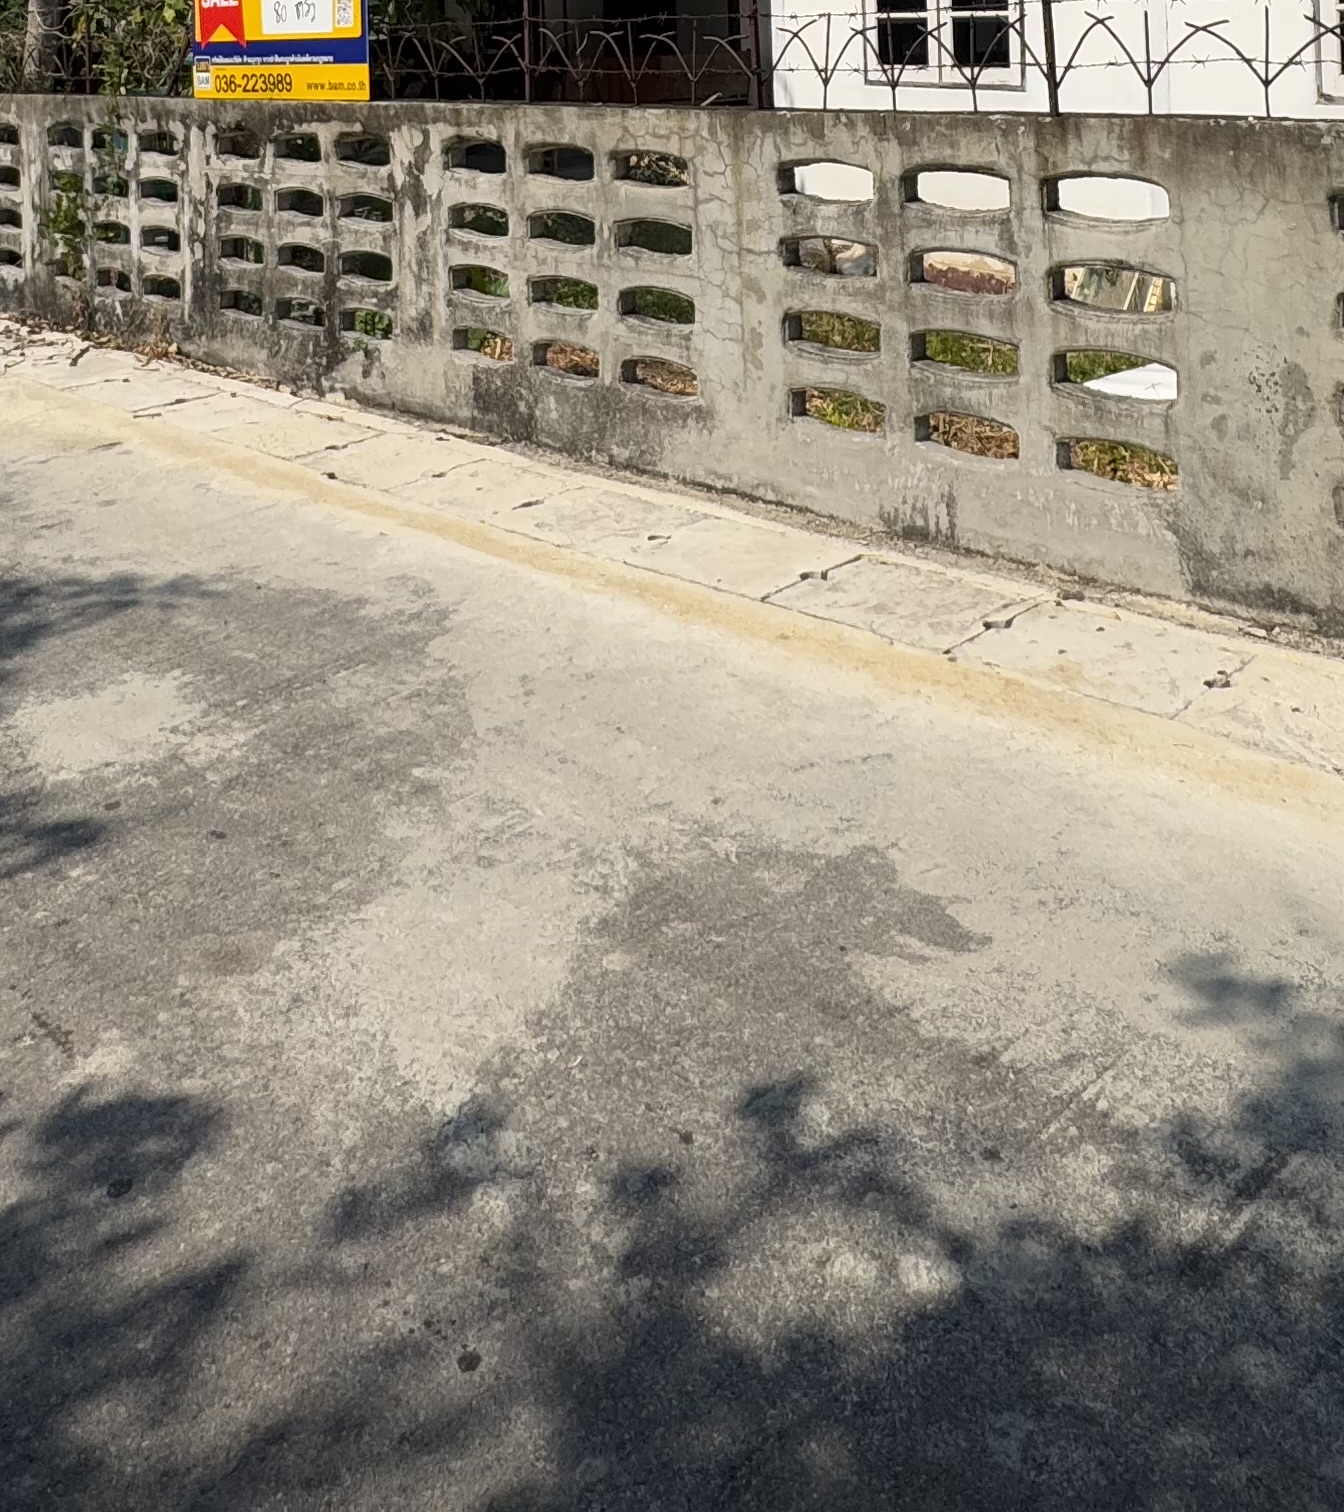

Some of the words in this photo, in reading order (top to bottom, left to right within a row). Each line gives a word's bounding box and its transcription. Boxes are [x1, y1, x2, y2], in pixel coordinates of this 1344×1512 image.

[273, 1, 287, 24] 80
[215, 73, 292, 93] 036-223989
[306, 79, 366, 91] www.bam.co.th
